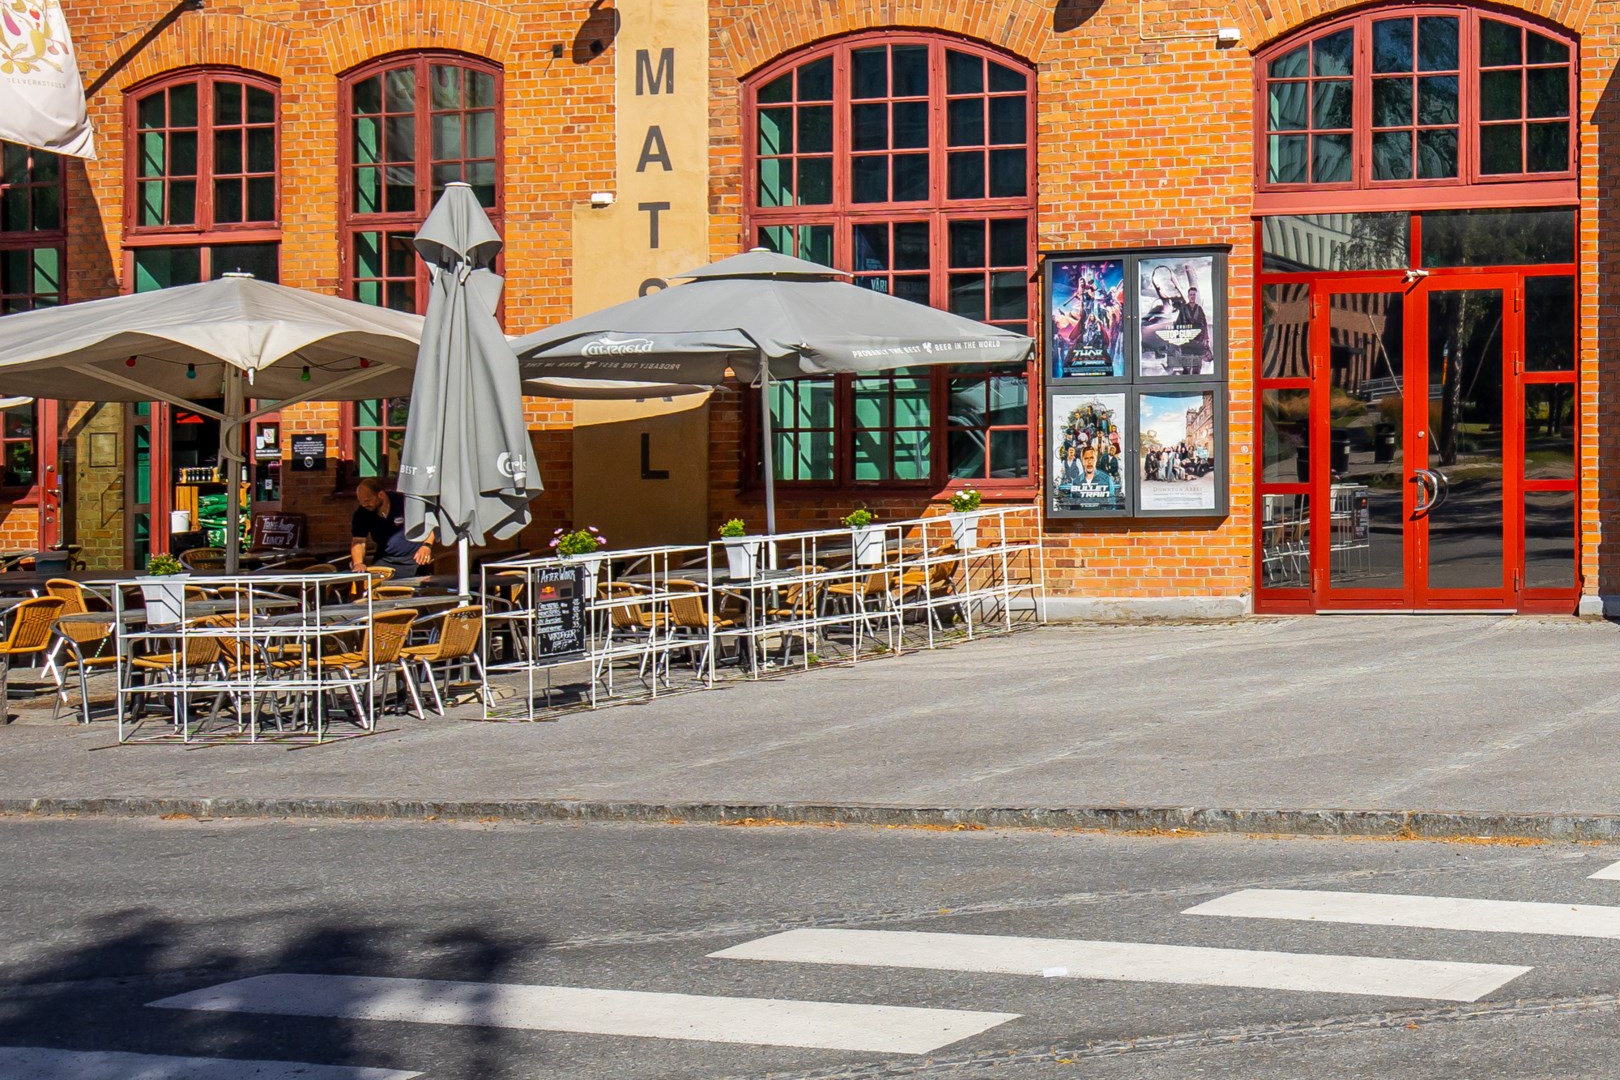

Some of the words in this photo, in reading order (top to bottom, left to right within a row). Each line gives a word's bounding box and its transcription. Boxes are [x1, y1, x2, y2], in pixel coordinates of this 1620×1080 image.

[635, 47, 675, 480] MATL
[851, 348, 889, 359] PROBABLY
[903, 345, 921, 354] BEST
[934, 343, 952, 351] BEER
[954, 342, 962, 350] IN
[963, 341, 977, 349] THE
[978, 340, 1001, 348] WORLD
[400, 464, 419, 476] BEST
